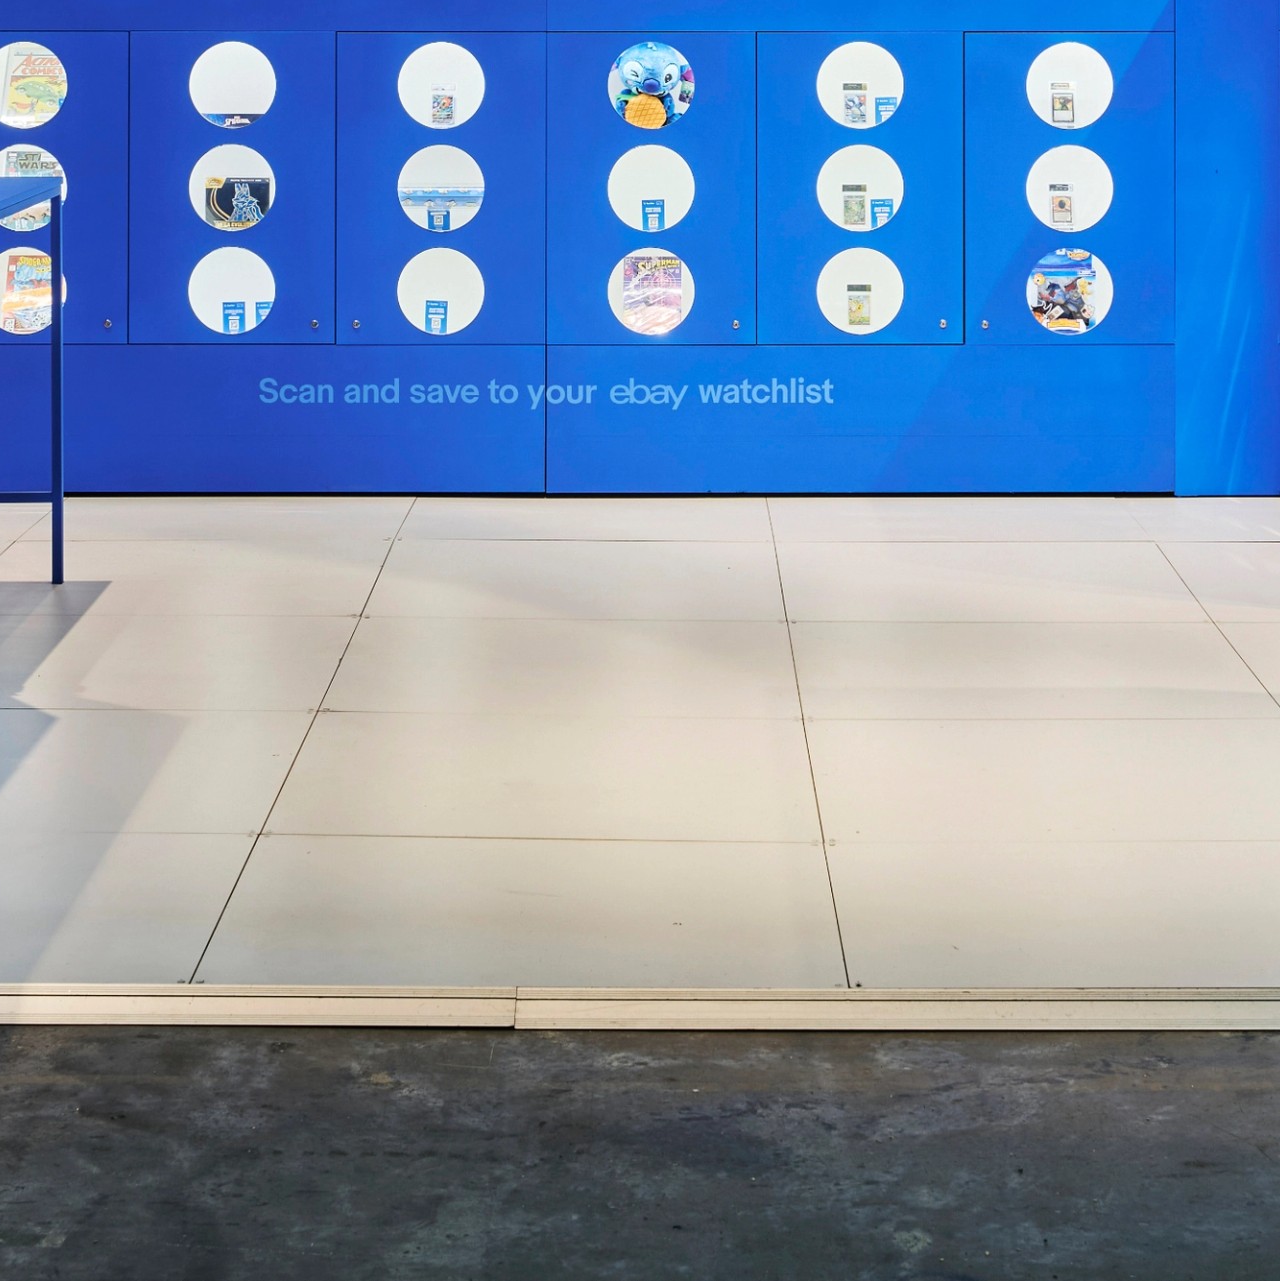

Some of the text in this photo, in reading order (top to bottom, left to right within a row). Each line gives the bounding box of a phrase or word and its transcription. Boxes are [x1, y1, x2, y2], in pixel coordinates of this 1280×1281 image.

[19, 161, 58, 169] WARS
[259, 377, 834, 410] Scan and save to your ebay watchlist
